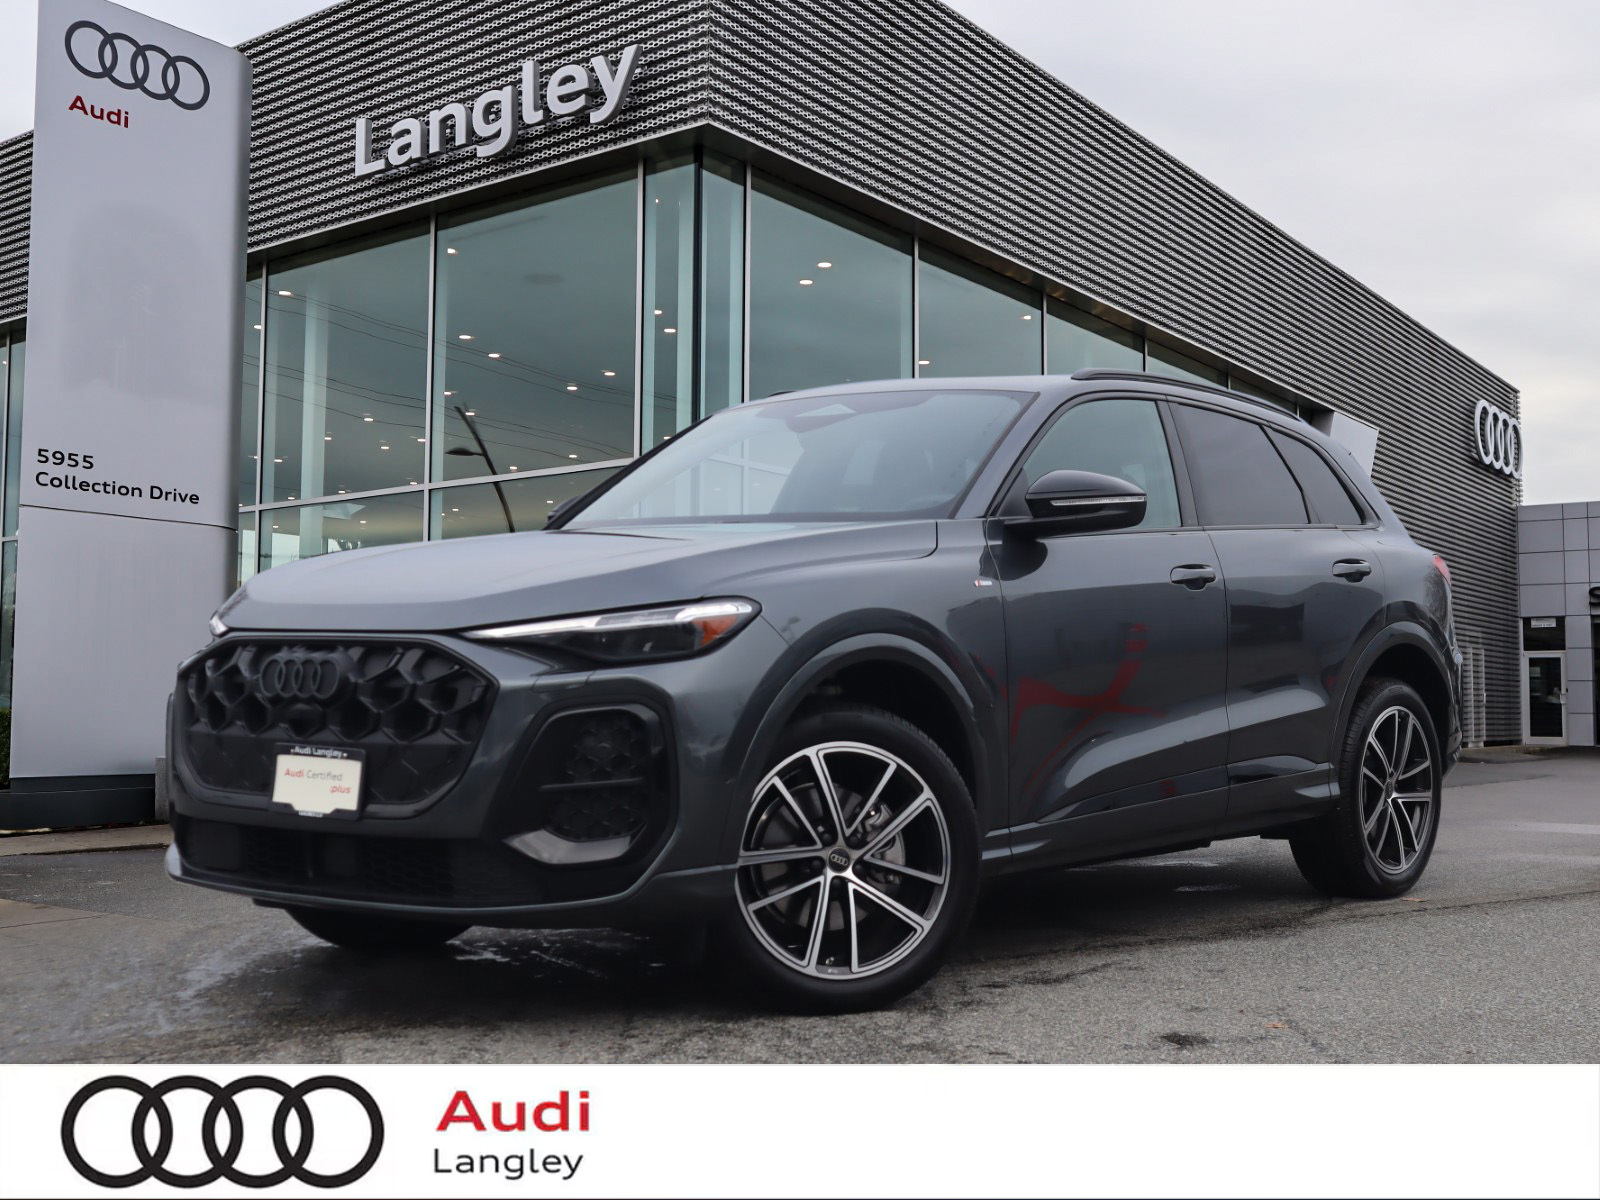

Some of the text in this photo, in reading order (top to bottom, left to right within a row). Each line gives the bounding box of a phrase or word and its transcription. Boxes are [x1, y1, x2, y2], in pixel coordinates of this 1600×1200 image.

[68, 95, 129, 128] Audi
[354, 43, 643, 177] Langley
[37, 448, 94, 470] 5955
[35, 471, 200, 505] Collection Drive
[294, 746, 343, 759] Audi Langley
[284, 768, 343, 781] Audi Certified
